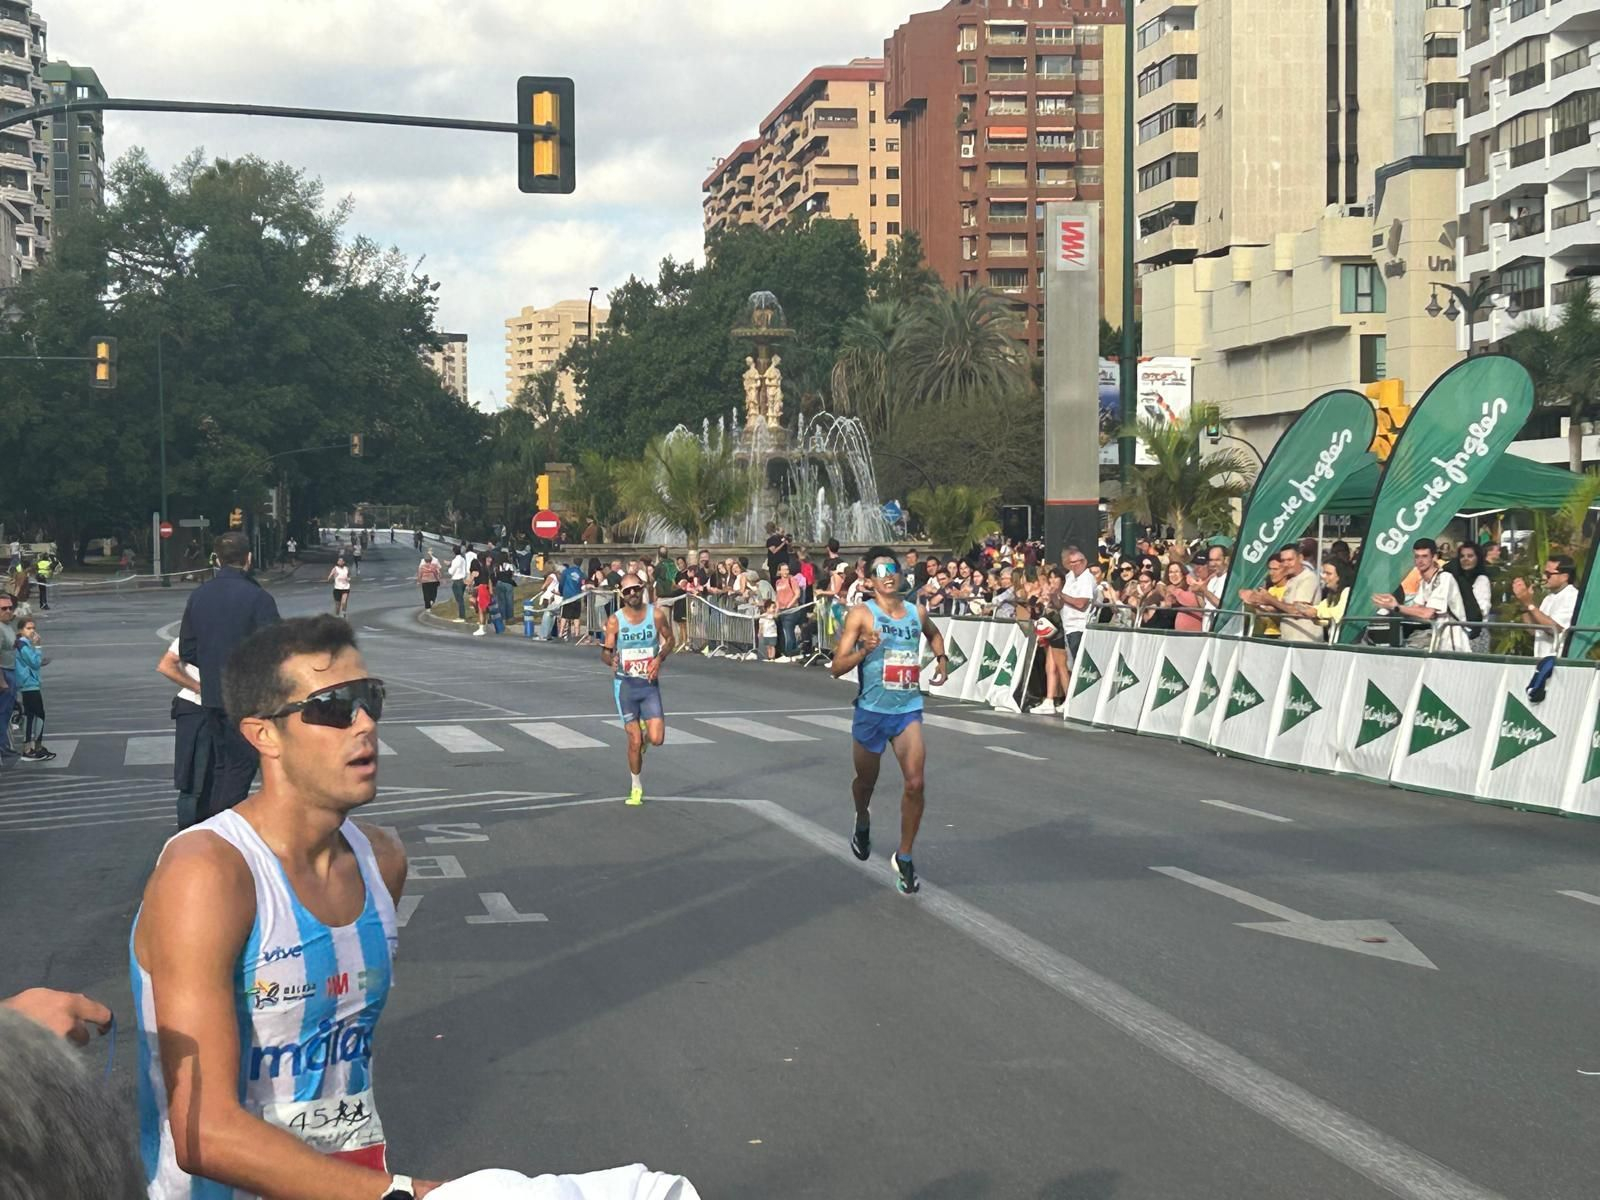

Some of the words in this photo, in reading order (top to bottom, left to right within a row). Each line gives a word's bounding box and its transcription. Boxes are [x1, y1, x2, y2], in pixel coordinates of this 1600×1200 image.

[1242, 540, 1268, 564] El
[1258, 495, 1303, 543] Corte
[1288, 428, 1353, 503] Inglés
[1375, 527, 1410, 556] El
[1396, 476, 1451, 532] Corte
[1430, 397, 1508, 485] Inglés
[622, 629, 654, 641] nerja
